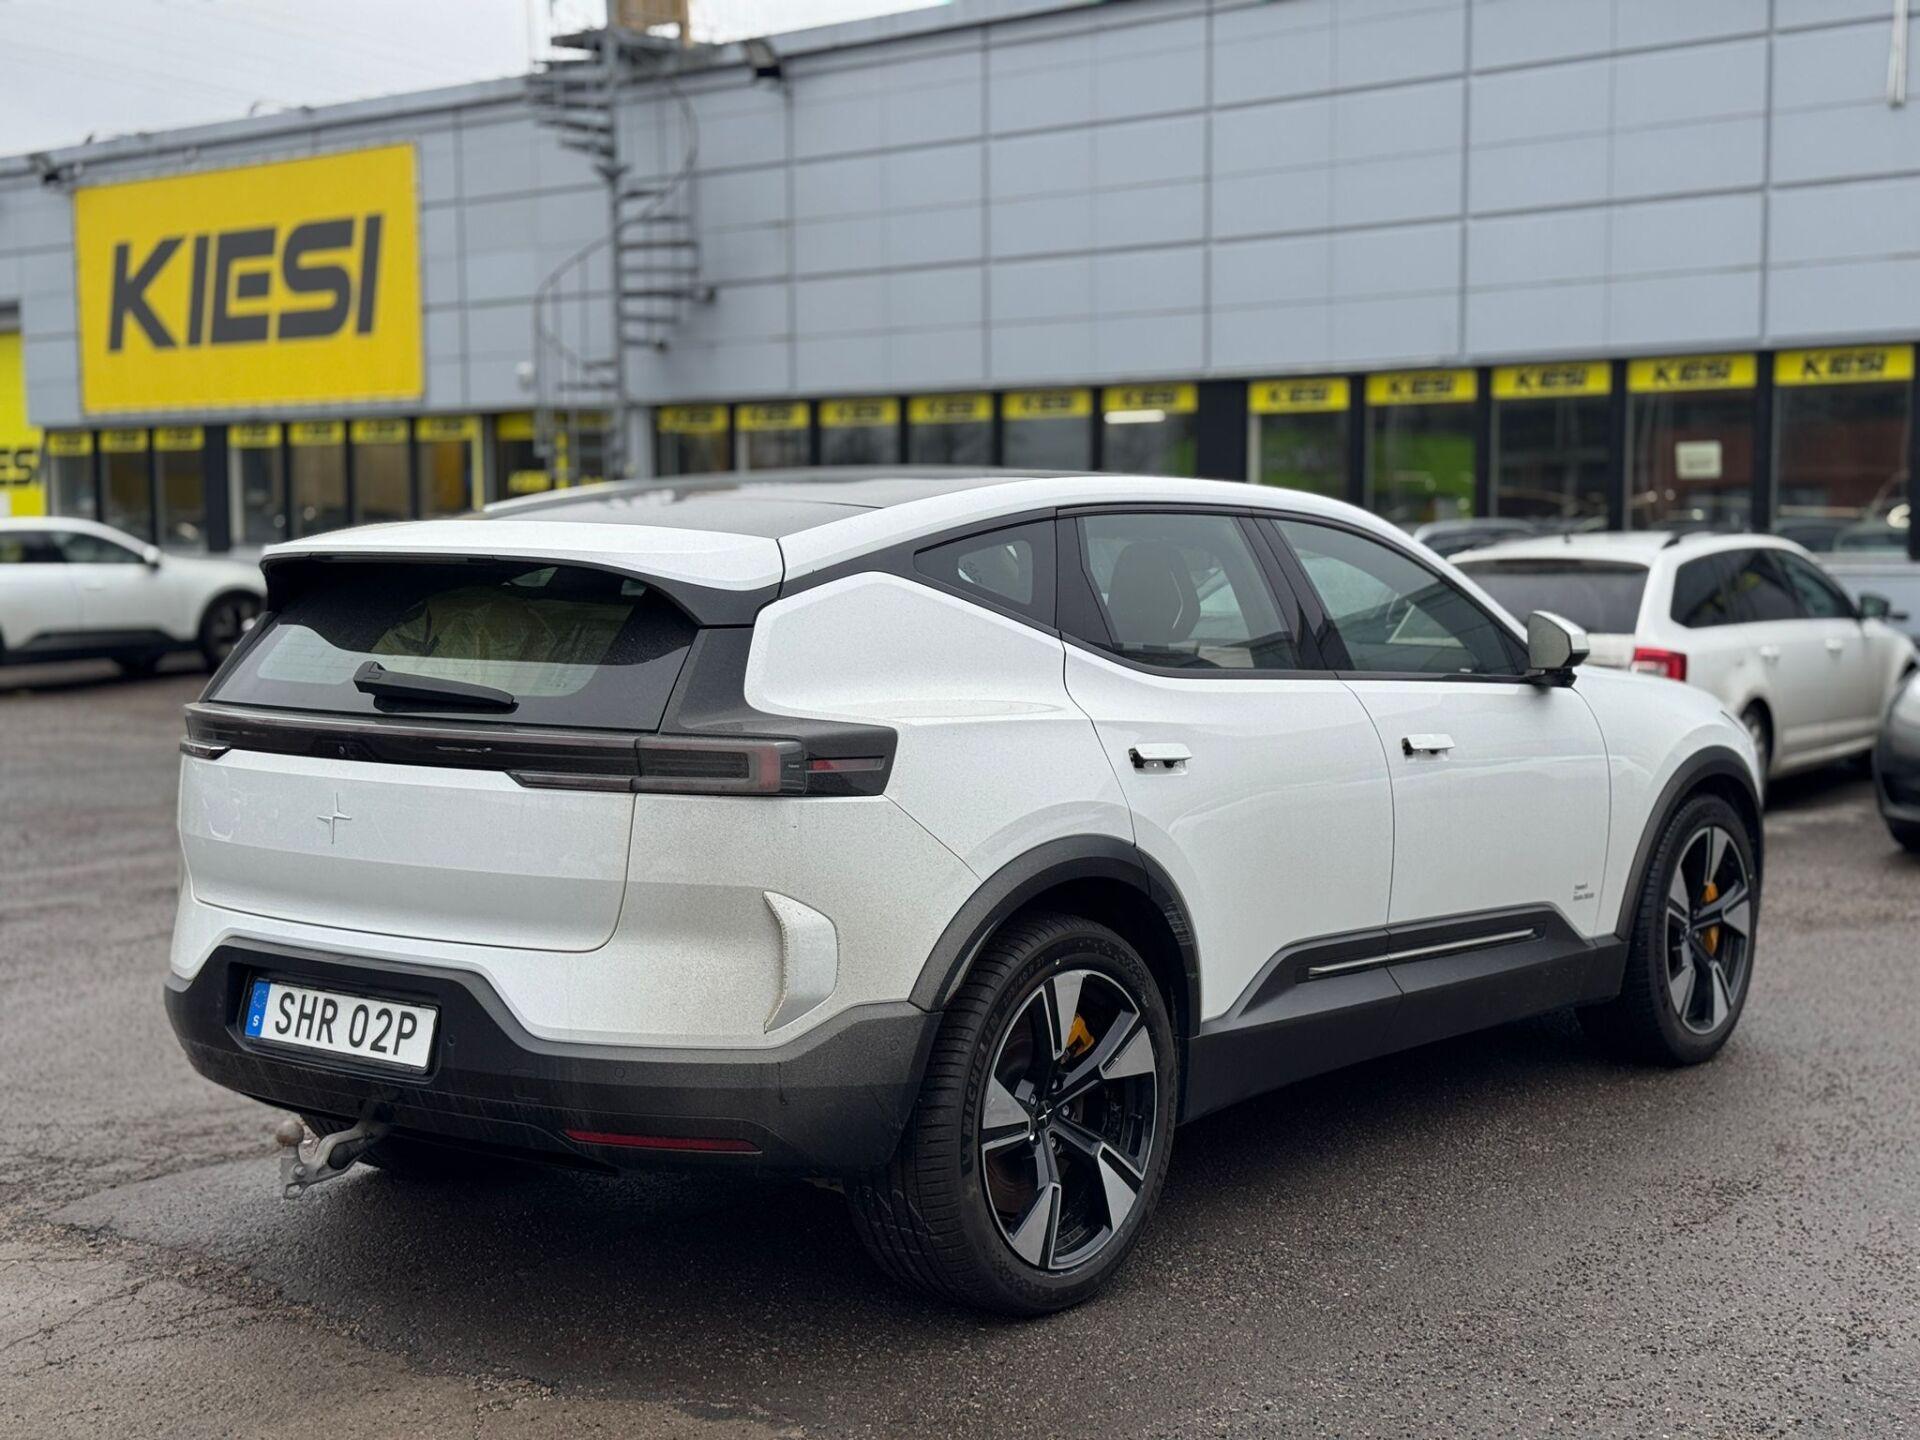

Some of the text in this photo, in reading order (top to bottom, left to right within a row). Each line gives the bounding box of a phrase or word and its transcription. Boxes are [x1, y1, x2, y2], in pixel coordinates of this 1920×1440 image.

[107, 213, 384, 352] KIESI
[252, 1015, 260, 1027] S
[275, 992, 417, 1056] SHR 02P
[962, 1012, 1000, 1137] MICHELIN
